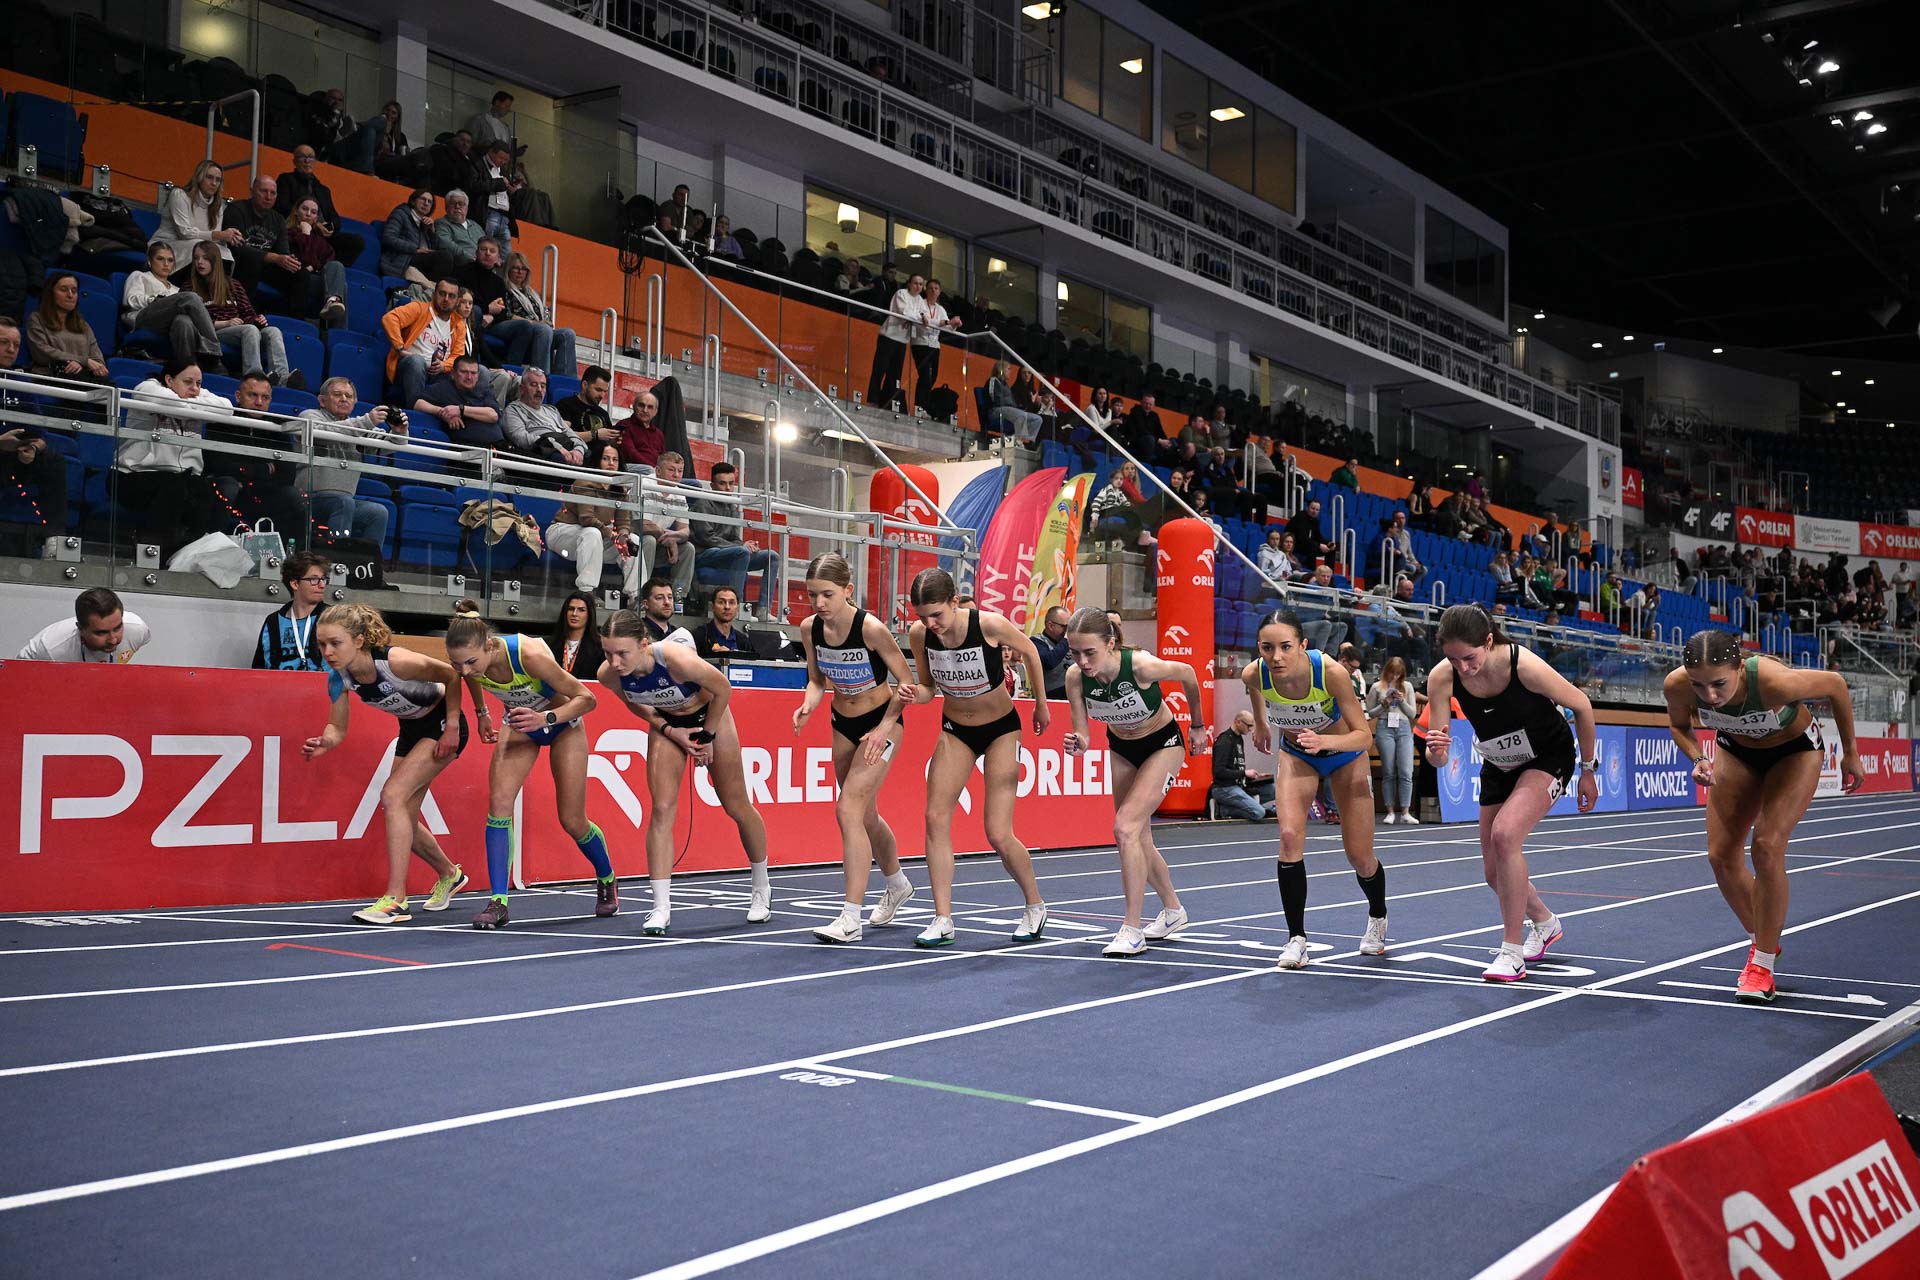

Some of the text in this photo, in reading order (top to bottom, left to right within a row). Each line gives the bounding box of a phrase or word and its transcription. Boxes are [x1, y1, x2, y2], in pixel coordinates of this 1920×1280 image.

[1684, 507, 1701, 527] 4F
[1710, 511, 1732, 532] 4F
[1758, 521, 1791, 537] ORLEN
[841, 651, 864, 662] 220
[955, 651, 978, 663] 202
[1162, 647, 1192, 656] ORLEN
[931, 668, 985, 684] STRZĄBAŁA
[655, 690, 676, 699] 409
[1090, 688, 1104, 697] 4F
[1114, 696, 1137, 711] 165
[1892, 689, 1906, 712] VIP
[1292, 705, 1316, 713] 294
[1740, 713, 1767, 725] 137
[1164, 735, 1178, 747] 4F
[1496, 735, 1522, 750] 178
[1635, 739, 1679, 766] KUJAWY
[1891, 754, 1909, 774] ORLEN
[1635, 771, 1688, 799] POMORZE
[19, 734, 450, 854] PZLA
[1808, 1155, 1913, 1261] ORLEN
